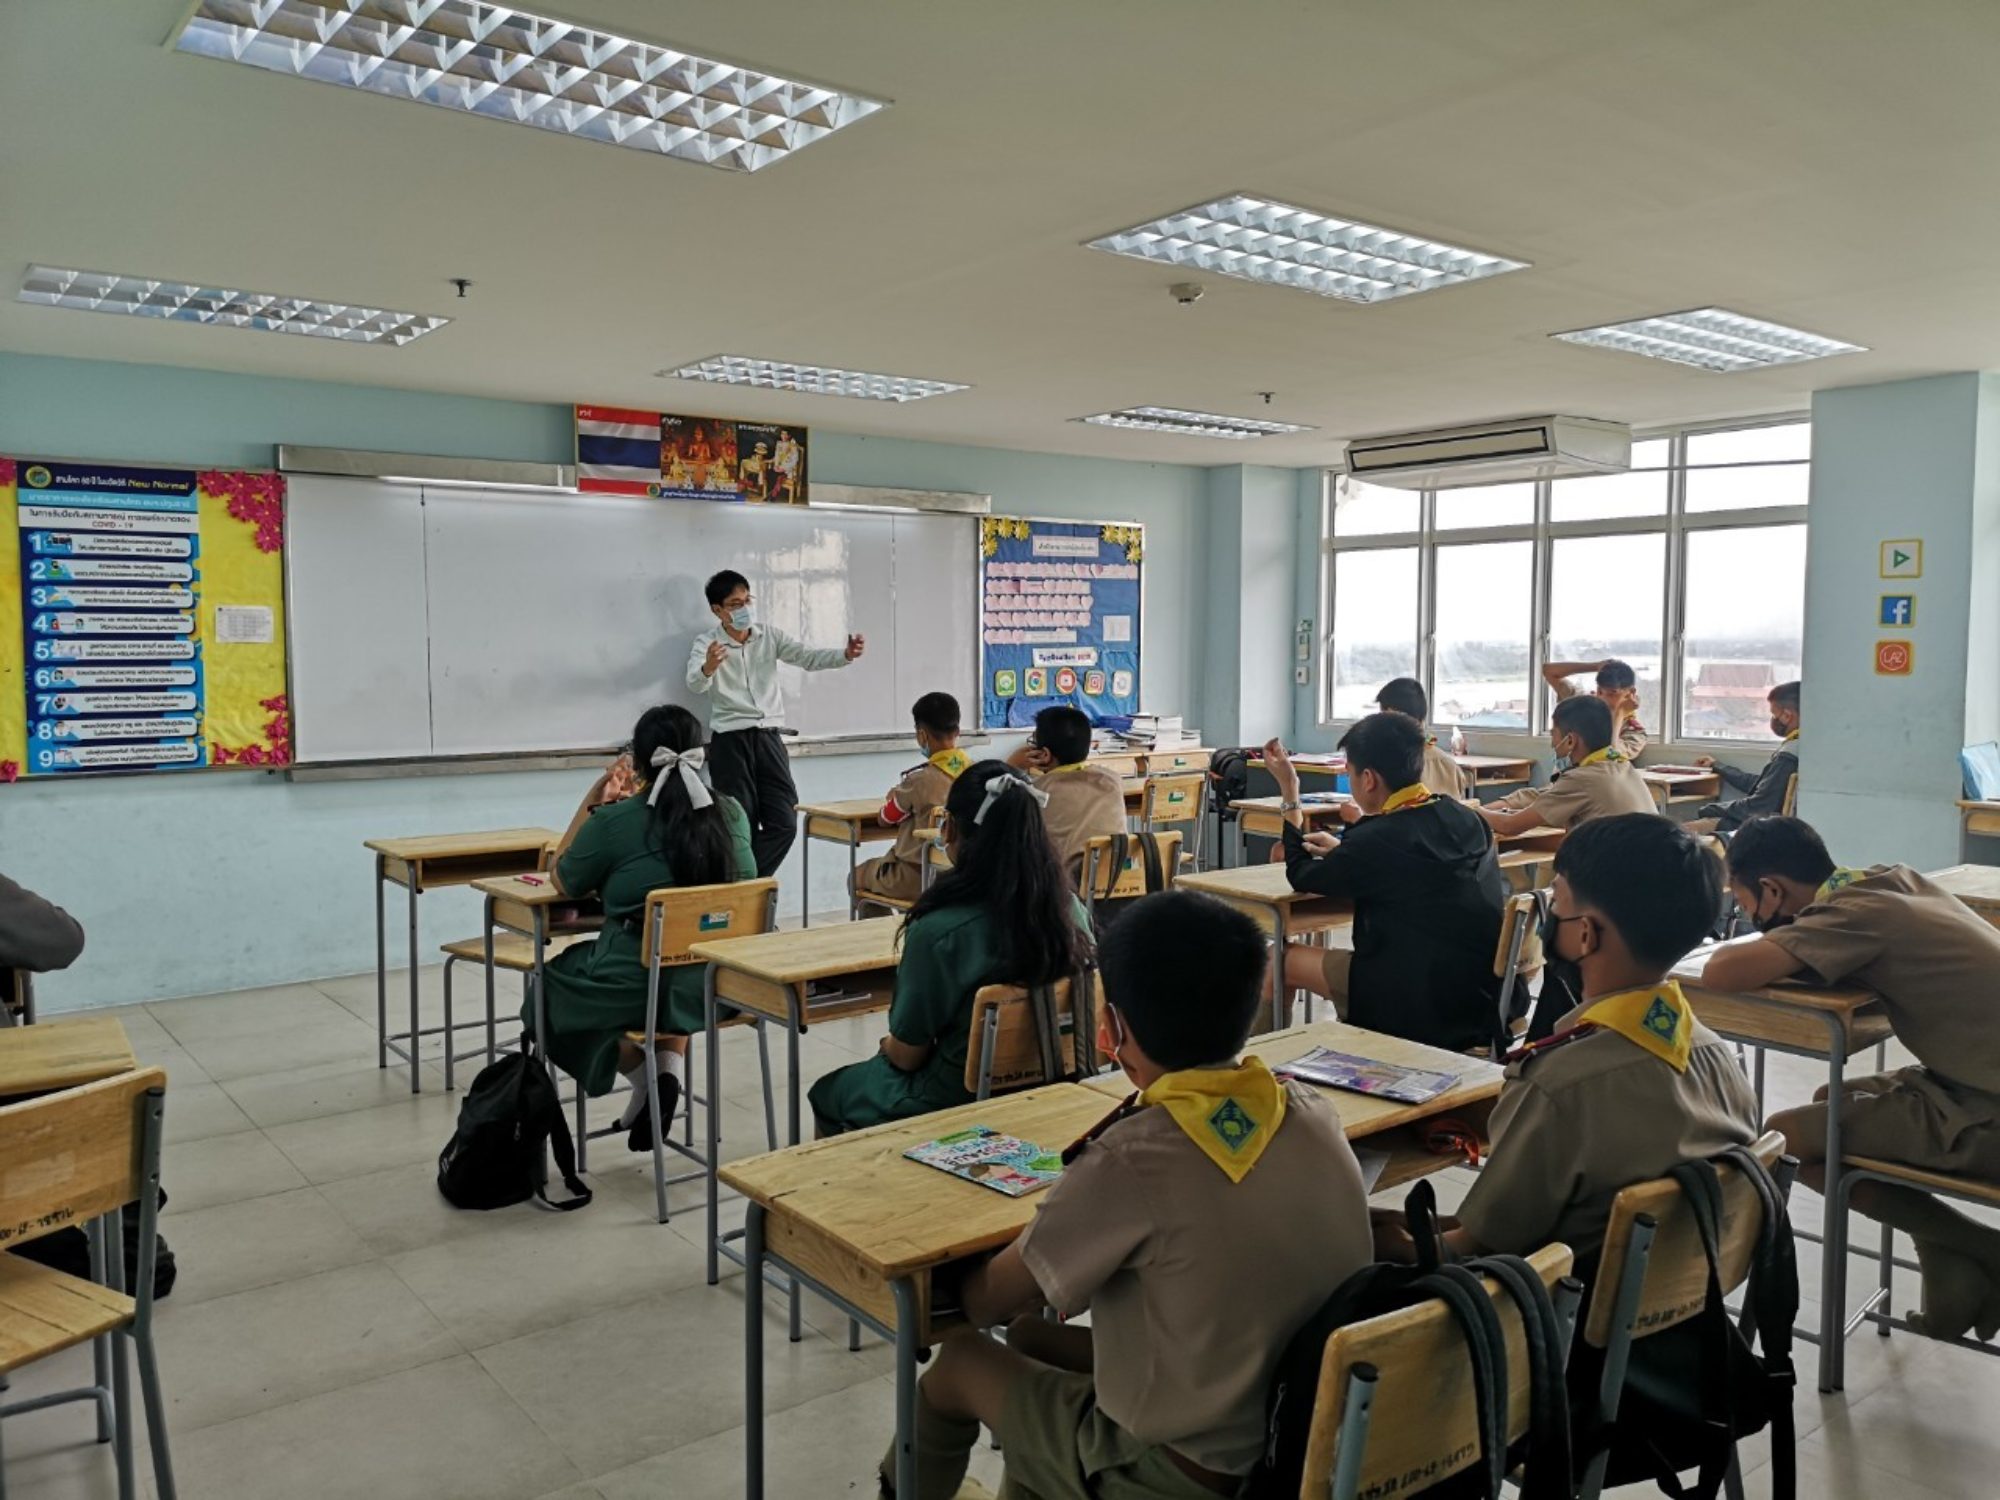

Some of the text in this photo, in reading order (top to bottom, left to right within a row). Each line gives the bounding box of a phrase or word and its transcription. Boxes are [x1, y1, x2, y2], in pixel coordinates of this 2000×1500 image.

[128, 479, 151, 488] New
[152, 480, 189, 490] Normal
[92, 521, 116, 529] COVID
[32, 534, 42, 552] 1
[30, 560, 46, 579] 2
[31, 588, 47, 606] 3
[1892, 599, 1908, 624] f
[33, 614, 48, 633] 4
[34, 641, 48, 659] 5
[35, 668, 50, 687] 6
[37, 695, 52, 713] 7
[38, 722, 52, 741] 8
[39, 750, 53, 768] 9
